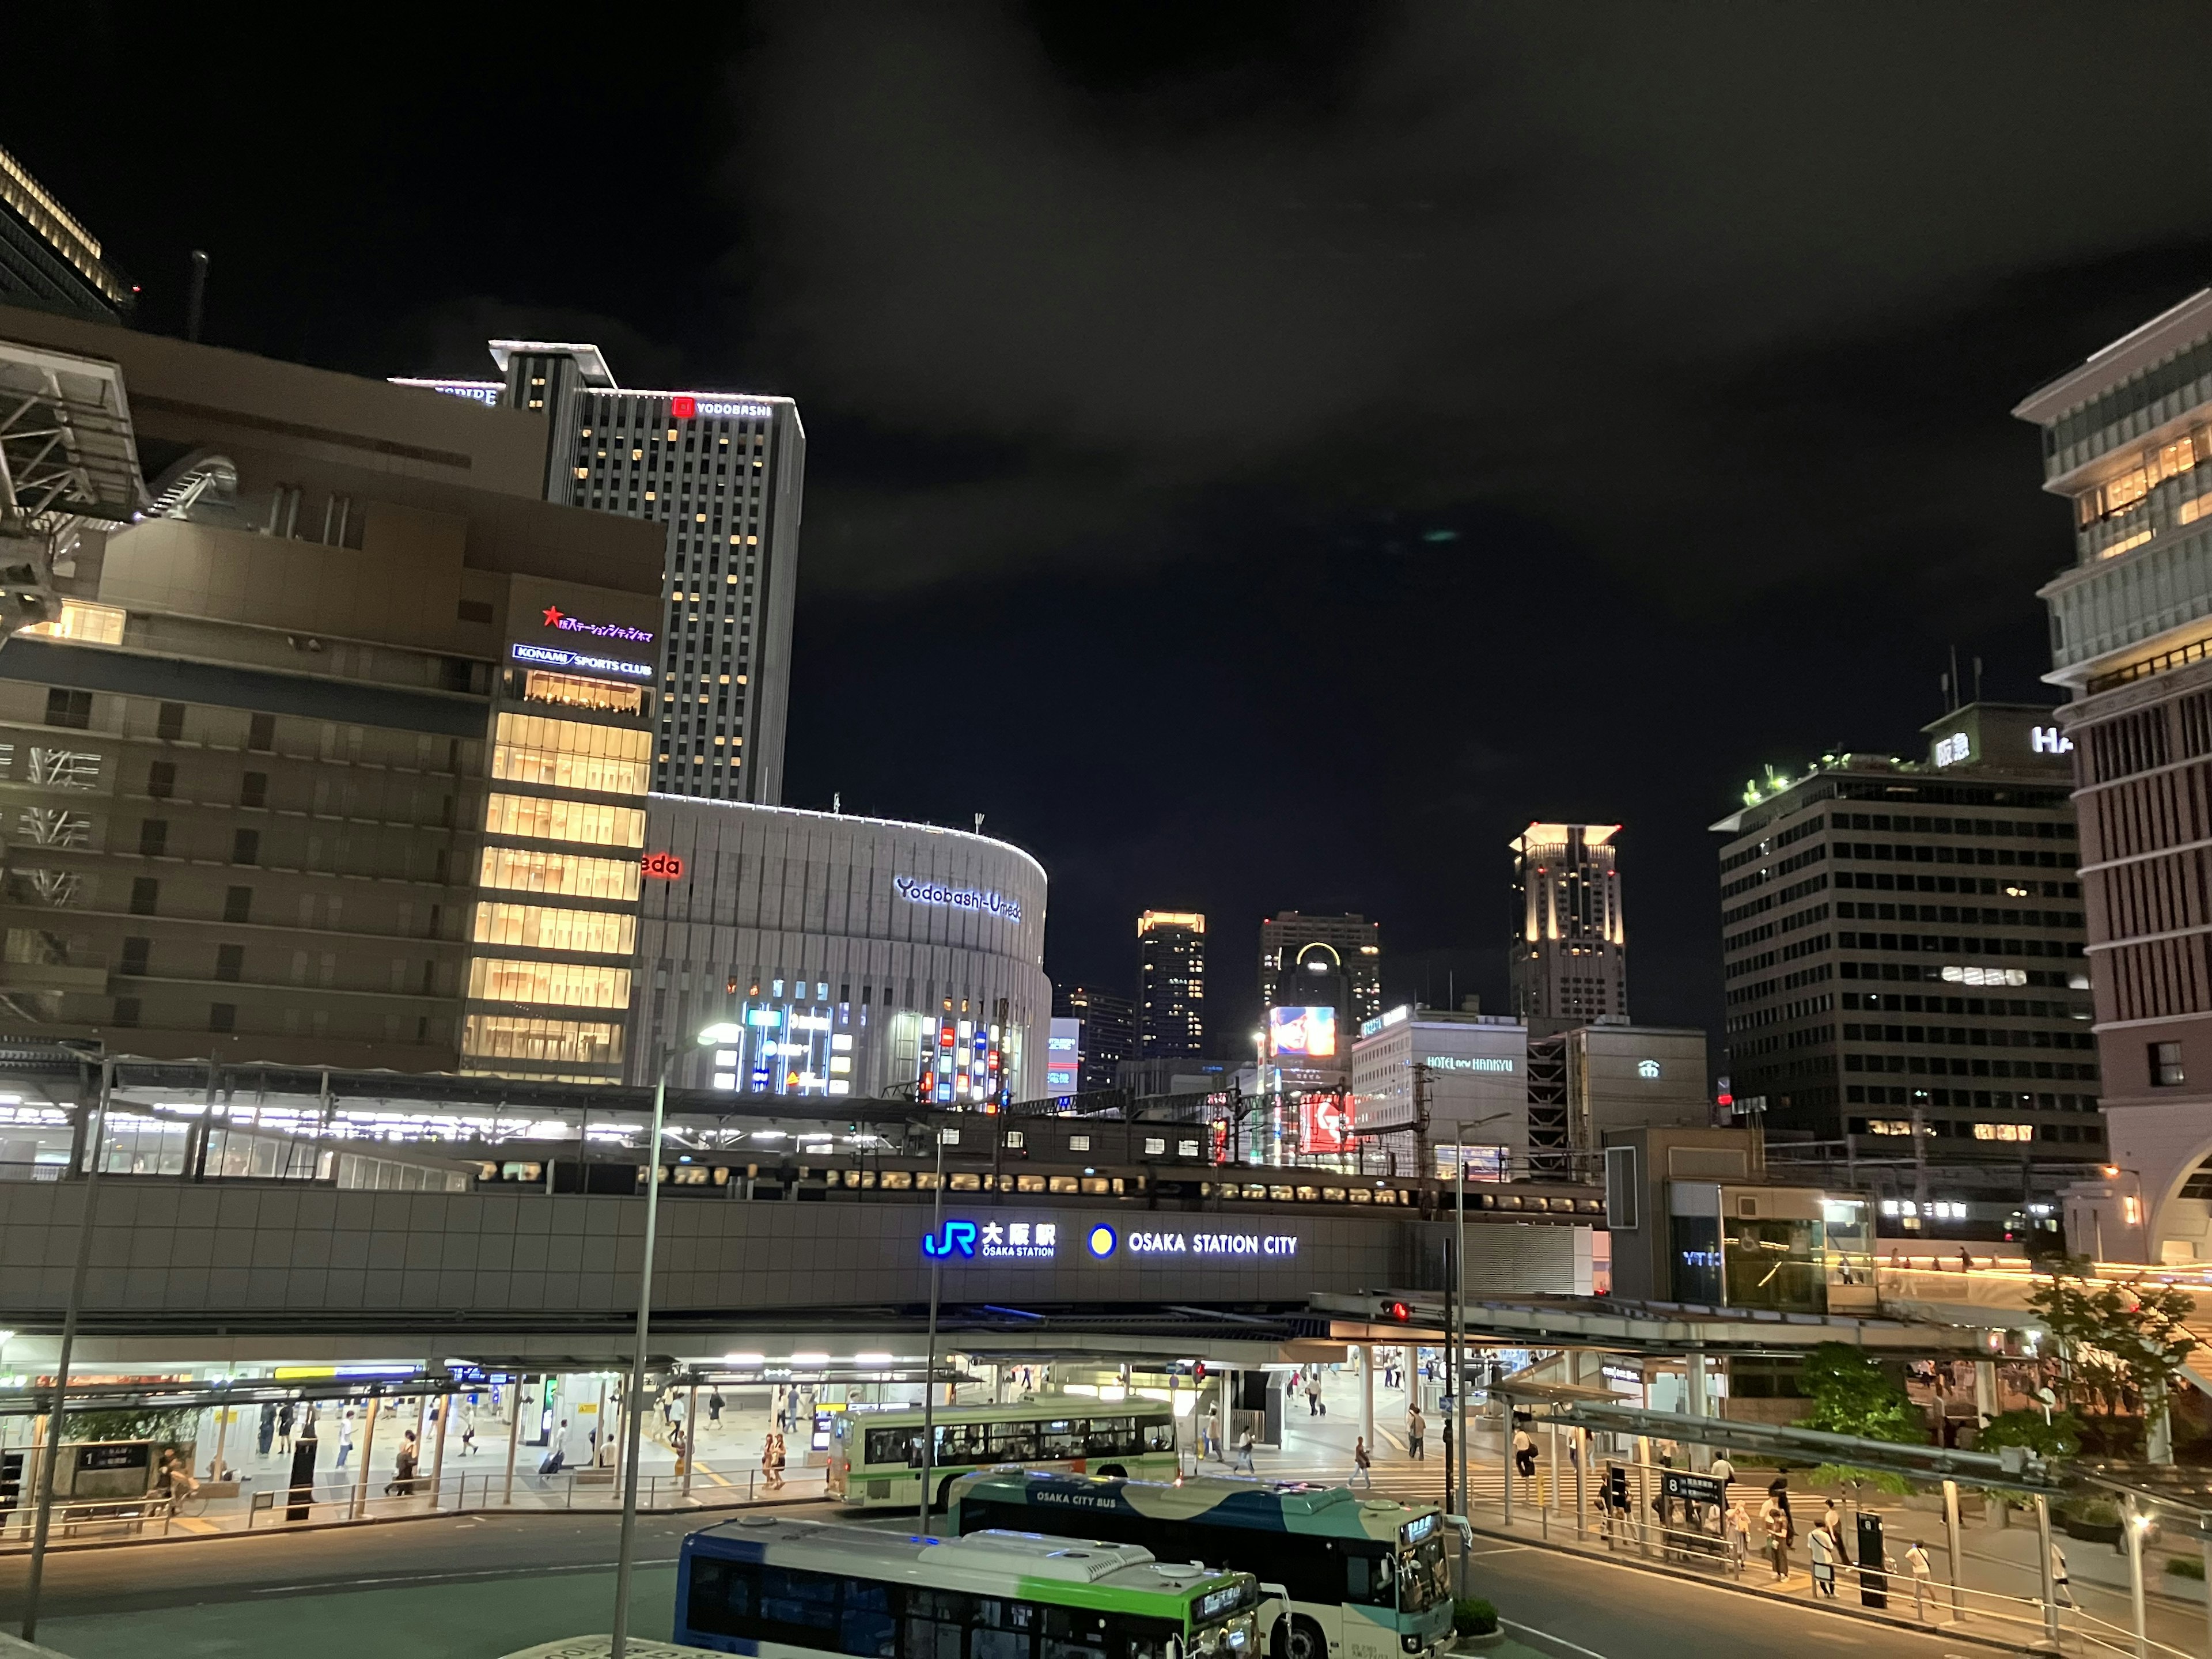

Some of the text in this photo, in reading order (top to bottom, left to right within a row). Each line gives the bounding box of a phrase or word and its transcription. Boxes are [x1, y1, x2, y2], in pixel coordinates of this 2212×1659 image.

[696, 403, 772, 416] YODOBASHI
[518, 646, 654, 676] KONAMI SPORTS CLUB
[1936, 732, 1970, 768] 阪急
[1427, 1056, 1513, 1072] HOTEL new HANKYU
[925, 1222, 974, 1255] JR
[982, 1221, 1056, 1246] 大阪駅
[1016, 1246, 1054, 1257] STATION
[1129, 1232, 1297, 1254] OSAKA STATION CITY
[85, 1453, 92, 1465] 1
[1669, 1479, 1678, 1492] 8
[1037, 1491, 1116, 1509] OSAKA CITY BUS
[1865, 1520, 1872, 1531] 8
